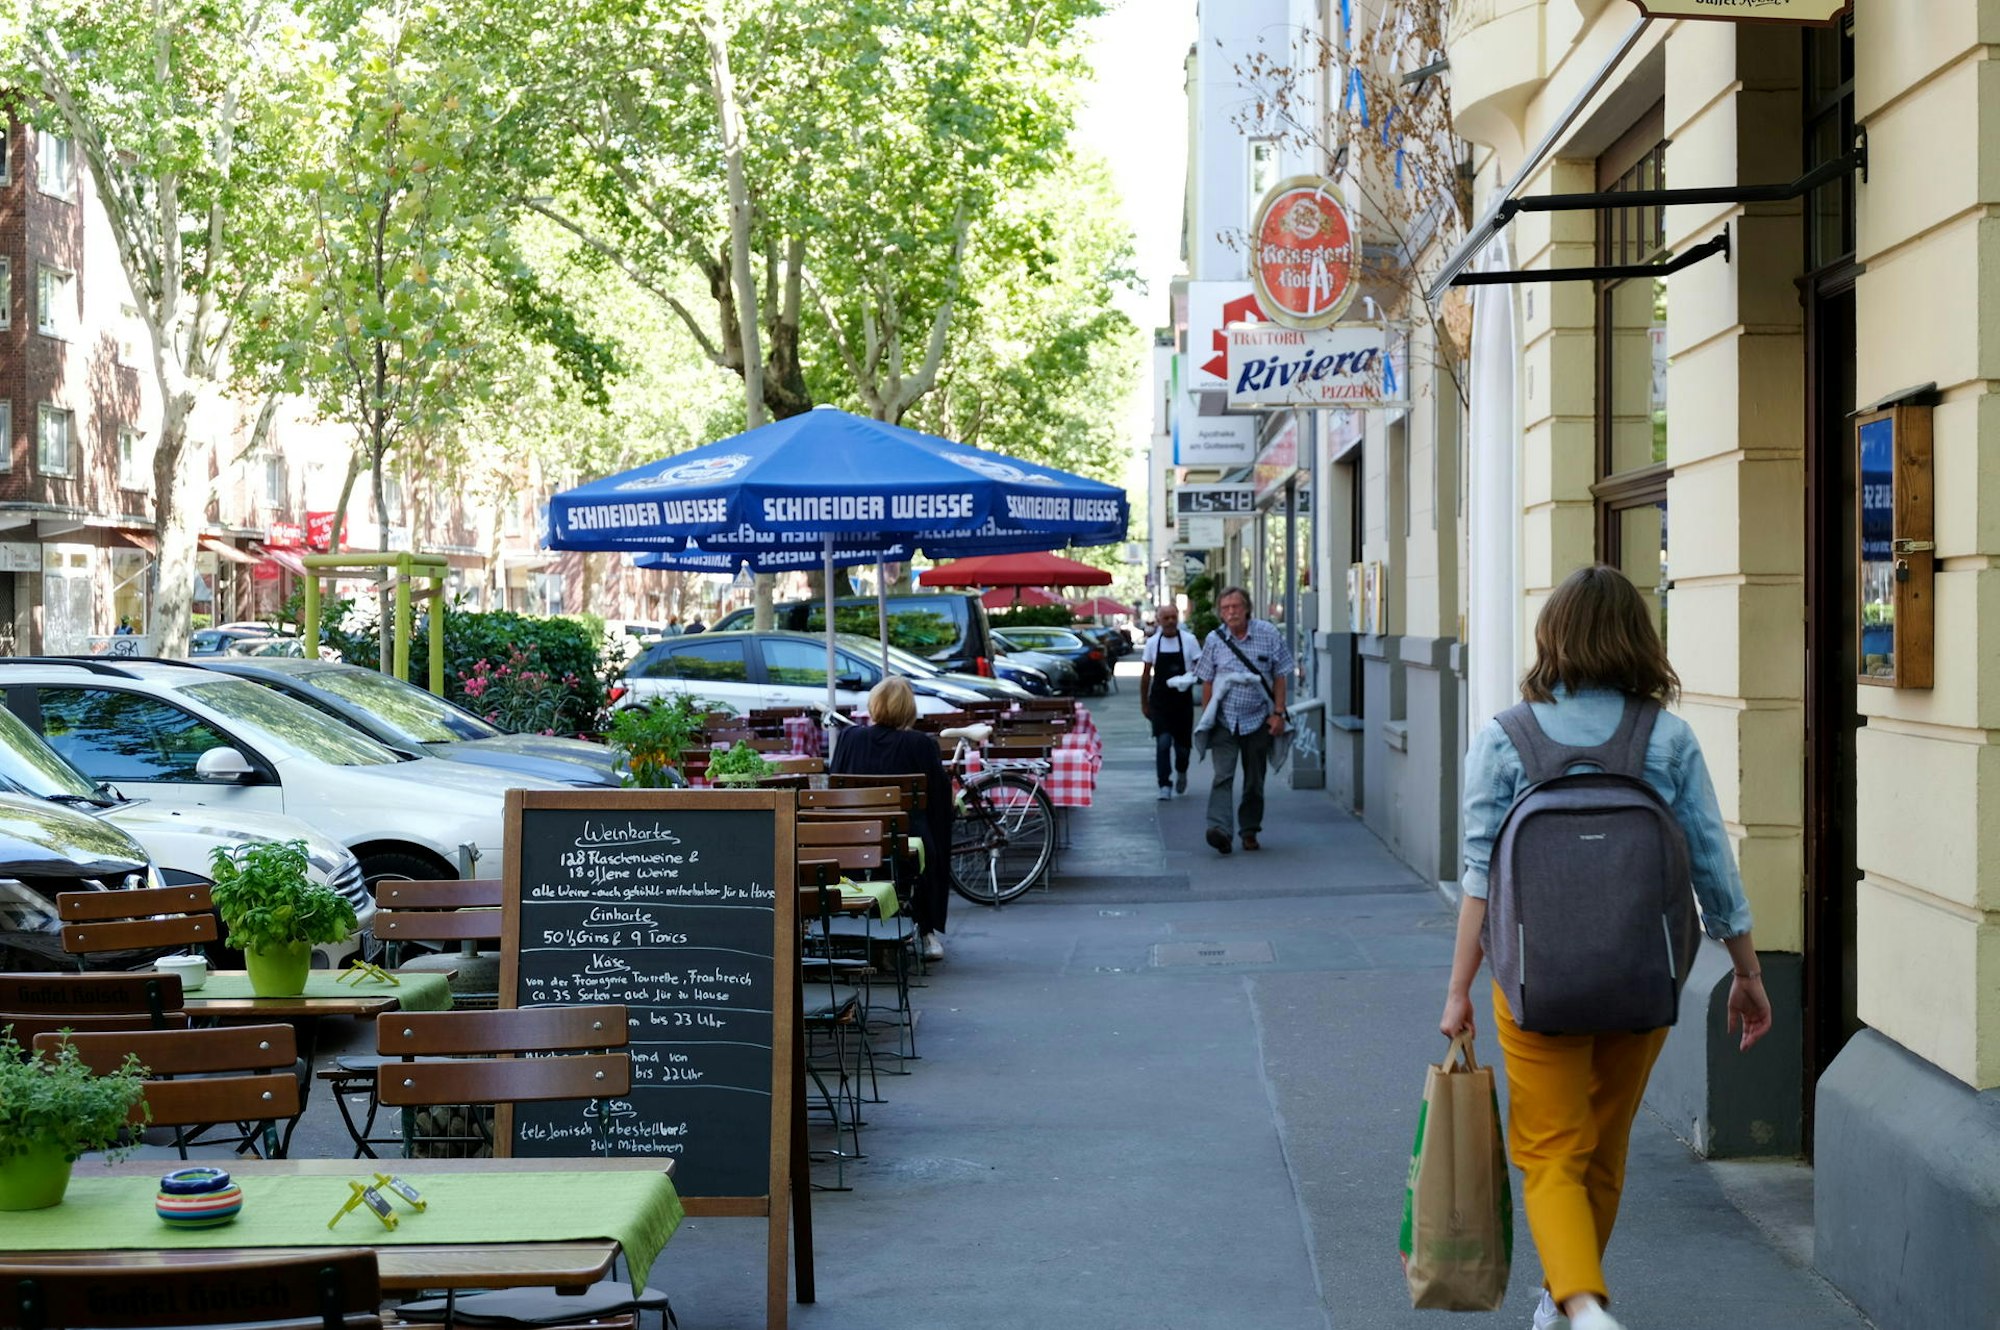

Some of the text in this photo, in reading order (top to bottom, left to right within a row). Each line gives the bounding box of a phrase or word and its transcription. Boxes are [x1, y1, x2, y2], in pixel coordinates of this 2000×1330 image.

[1233, 332, 1305, 346] TRATTORIA
[1236, 347, 1379, 395] Riviera
[567, 502, 661, 530] SCHNEIDER
[664, 498, 727, 525] WEISSE
[763, 494, 973, 521] SCHNEIDER WEISSE
[1006, 495, 1070, 520] SCHNEIDER
[583, 820, 674, 842] Weinkarte
[560, 850, 700, 867] 128 Flaschenweine &
[569, 866, 584, 879] 18
[587, 865, 631, 886] offene
[531, 883, 556, 898] alle
[721, 885, 737, 900] für
[589, 906, 653, 923] Ginkarte
[576, 930, 610, 944] Gins
[611, 931, 622, 946] &
[630, 930, 642, 946] 9
[648, 928, 688, 944] Tonics
[592, 952, 626, 970] Käse
[525, 977, 545, 988] von
[550, 976, 570, 987] der
[571, 973, 629, 991] Fromagerie
[687, 966, 753, 987] Frankreich
[532, 990, 551, 1001] ca.
[552, 989, 571, 1001] 35
[577, 988, 611, 1003] Sorten
[624, 987, 650, 1001] auch
[652, 987, 672, 1003] für
[694, 987, 731, 1002] Hause
[650, 1011, 669, 1027] bis
[673, 1012, 693, 1027] 23
[697, 1012, 727, 1029] Uhr
[669, 1052, 689, 1063] von
[635, 1064, 654, 1079] bis
[589, 1098, 634, 1113] Esen
[618, 1138, 685, 1154] Mitnehmen
